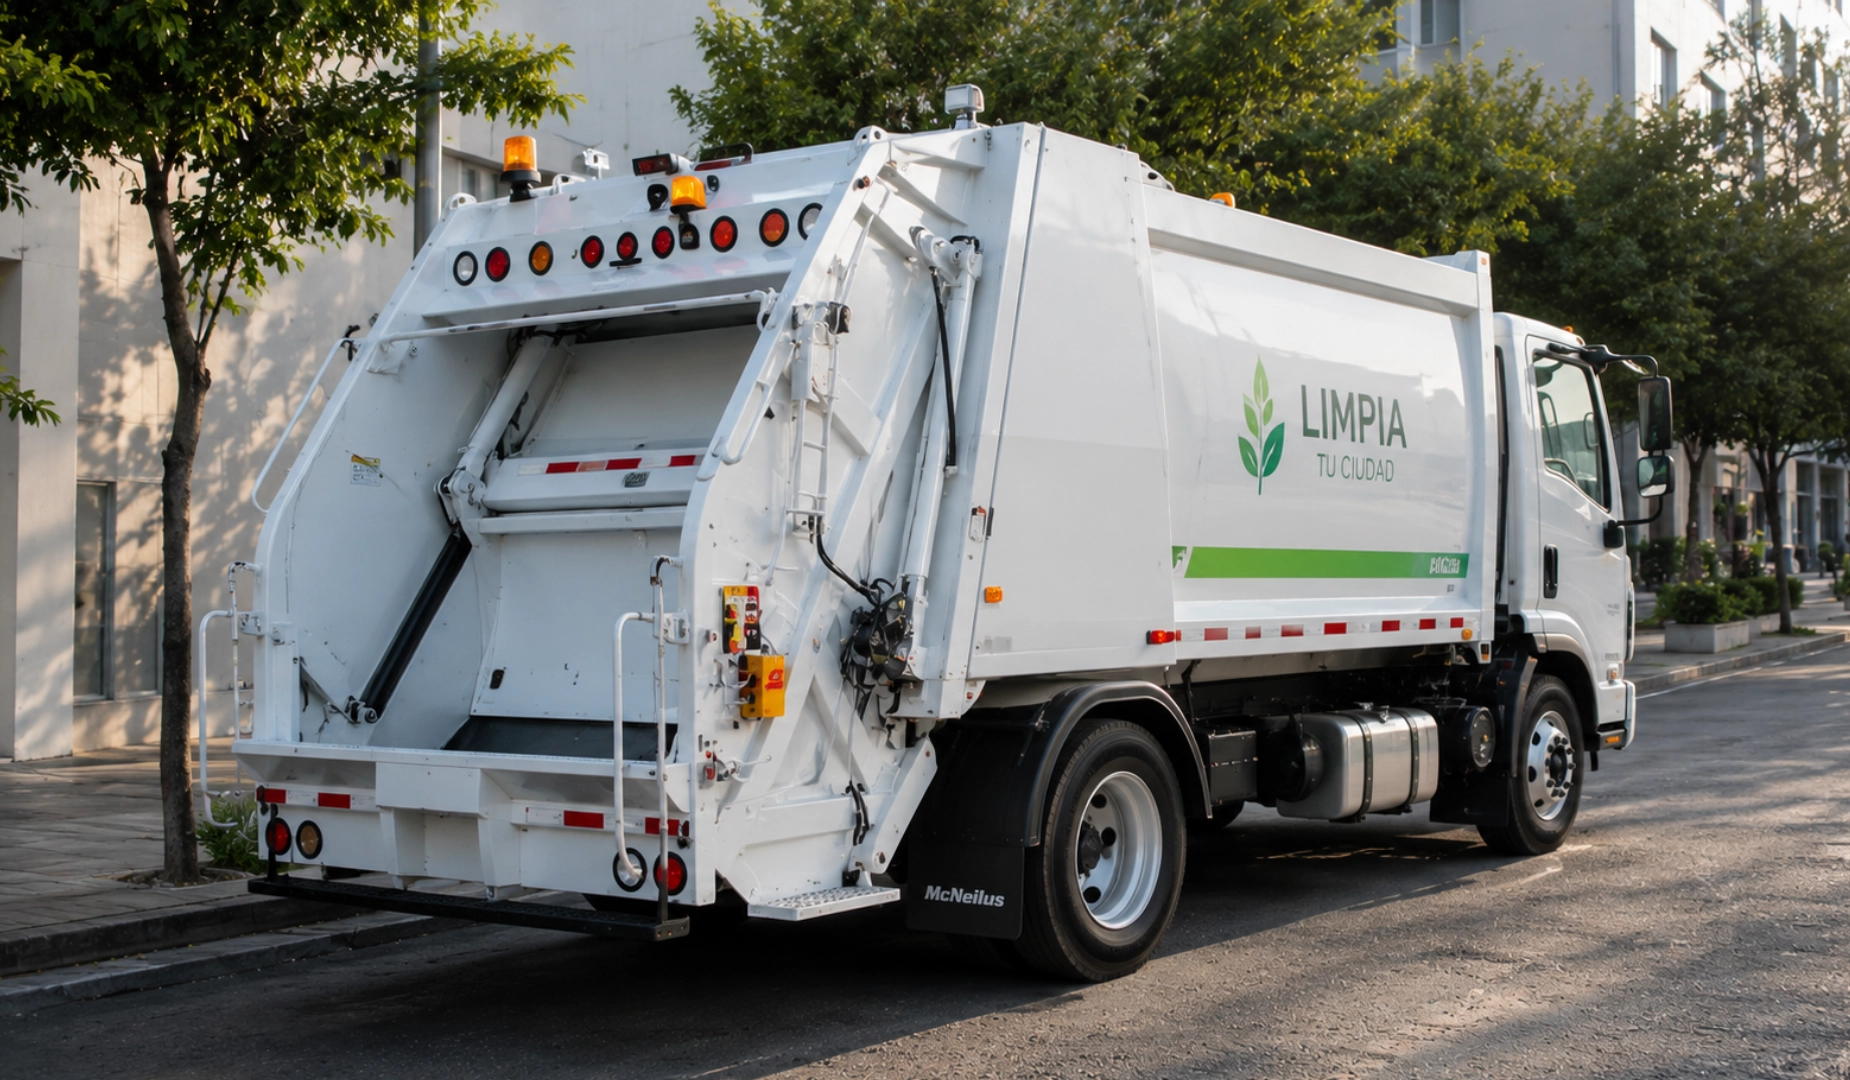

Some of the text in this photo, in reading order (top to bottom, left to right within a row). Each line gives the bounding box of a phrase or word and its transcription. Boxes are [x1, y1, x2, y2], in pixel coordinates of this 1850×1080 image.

[1301, 384, 1407, 449] LIMPIA
[1317, 453, 1394, 482] TU CIUDAD
[924, 885, 1005, 907] McNeilus
